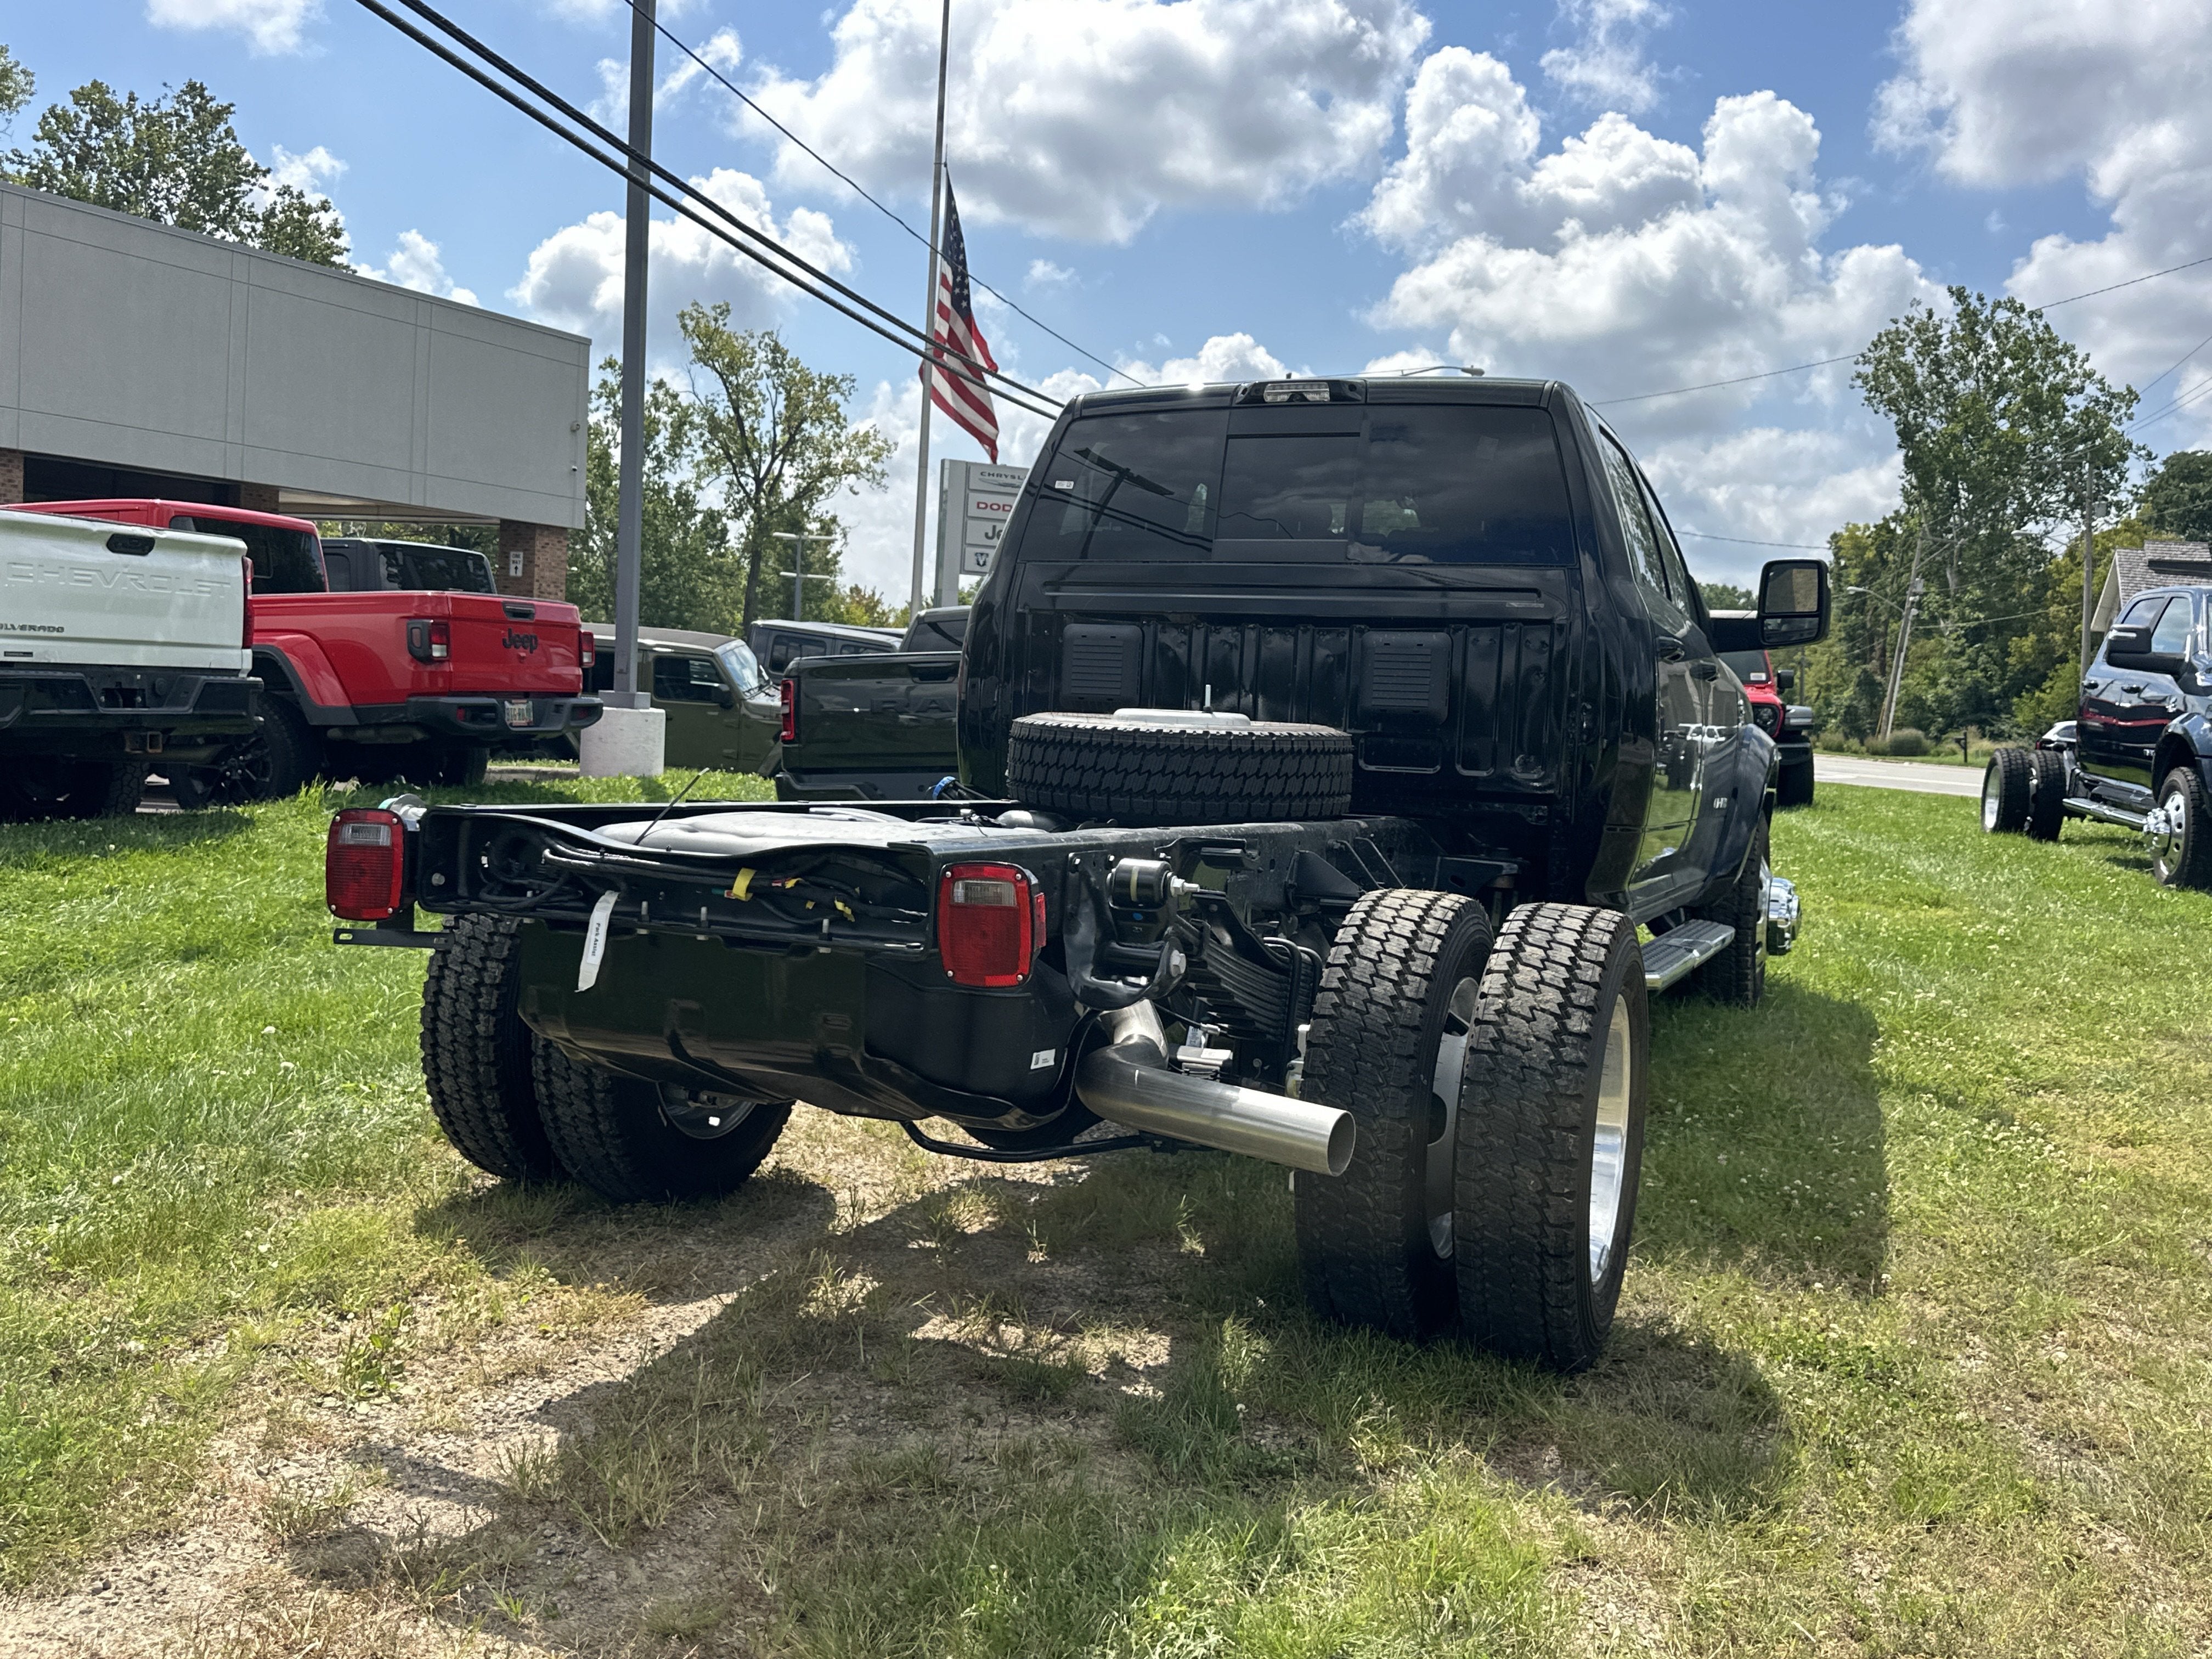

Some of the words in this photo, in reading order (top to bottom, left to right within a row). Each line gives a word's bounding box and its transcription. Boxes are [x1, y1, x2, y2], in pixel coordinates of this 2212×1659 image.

[980, 471, 1026, 481] CHRYSL
[7, 562, 231, 599] CHEVROLET
[502, 628, 538, 654] Jeep
